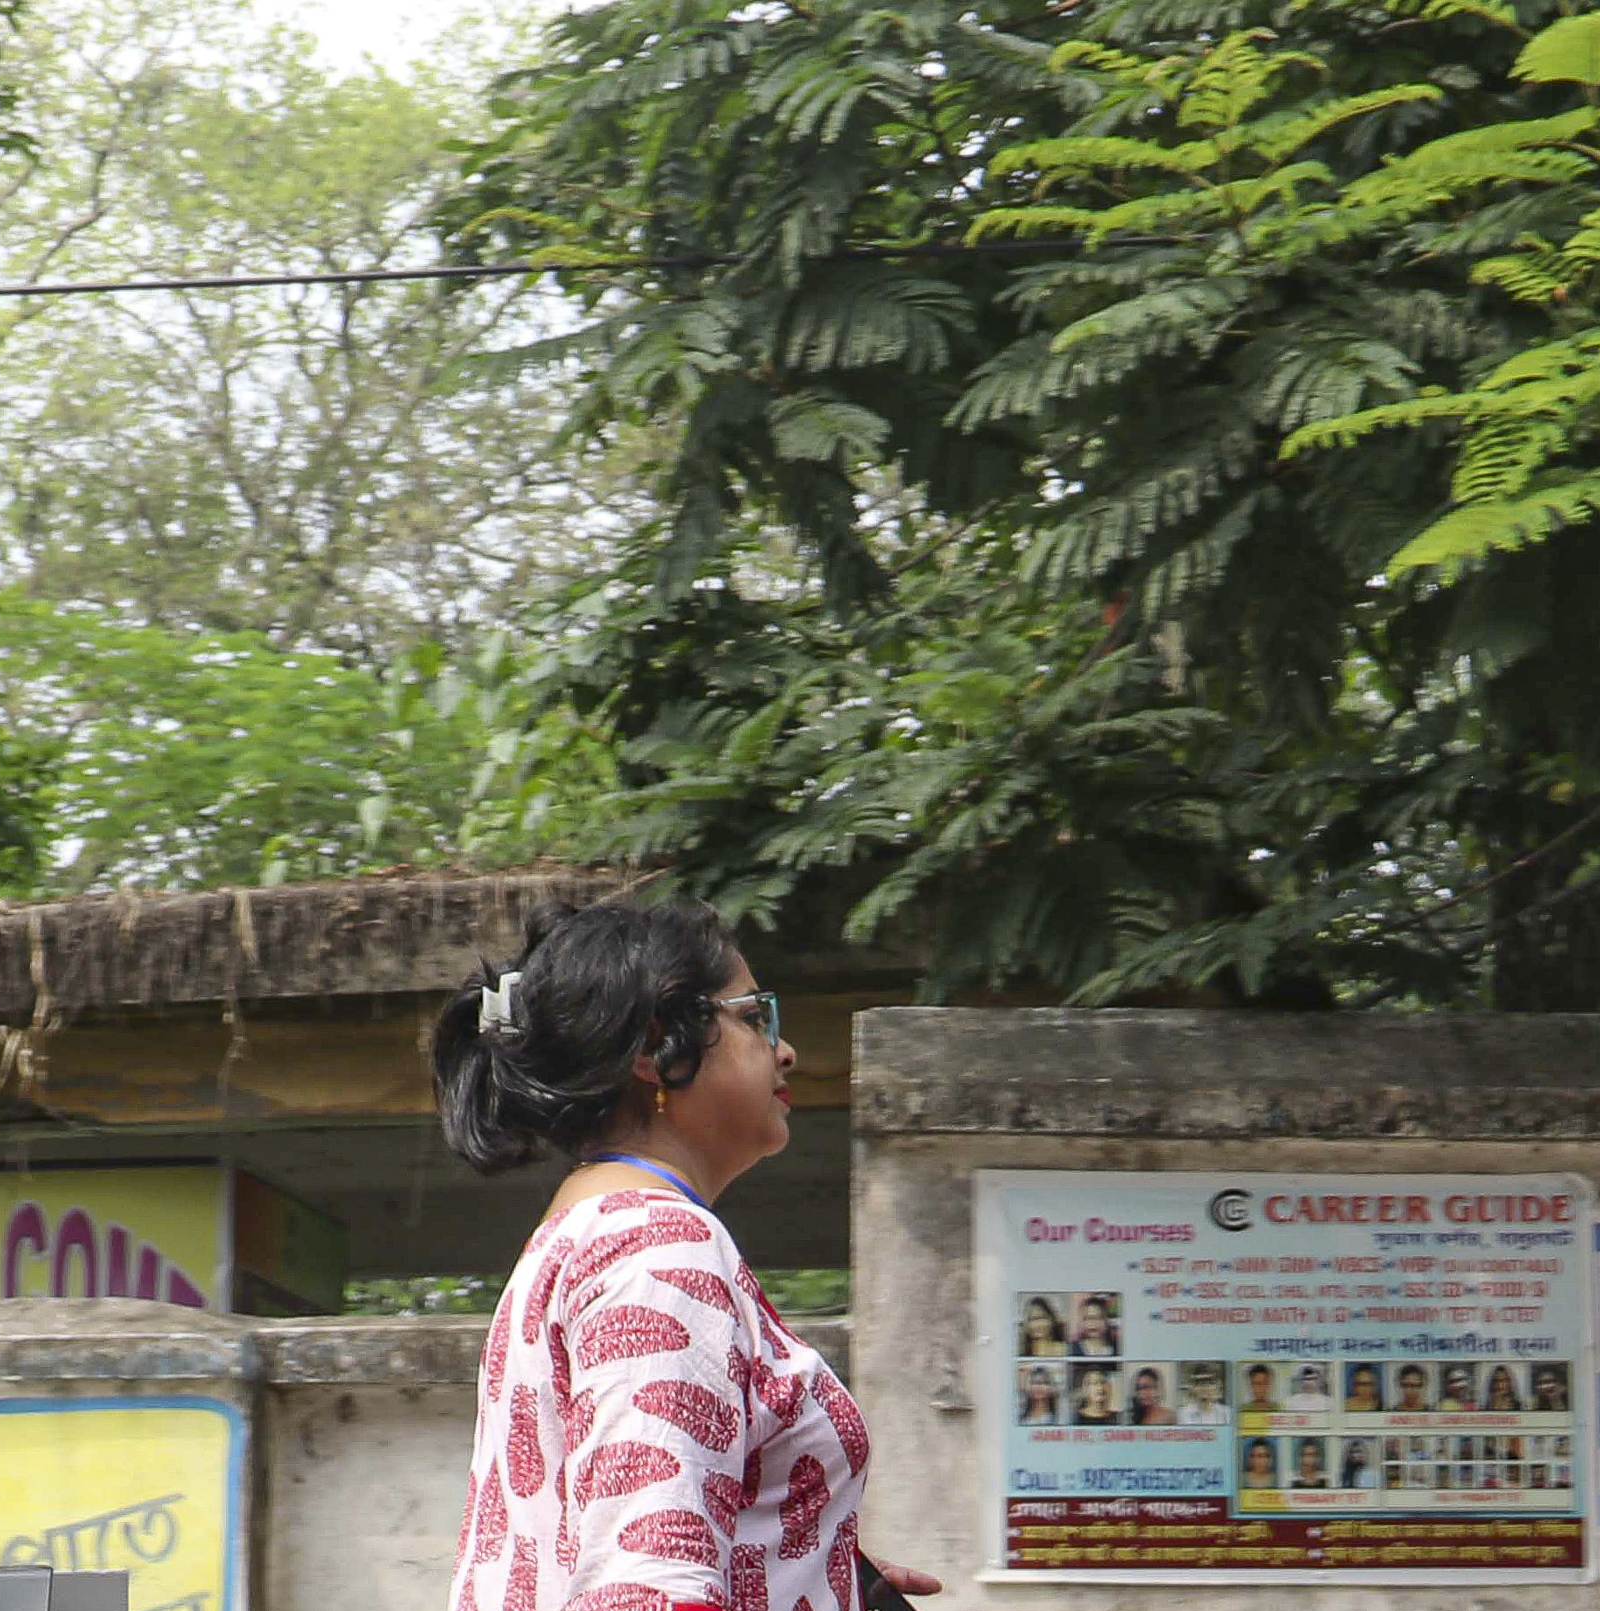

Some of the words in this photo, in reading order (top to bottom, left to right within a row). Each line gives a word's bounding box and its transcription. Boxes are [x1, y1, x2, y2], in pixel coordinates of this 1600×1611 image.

[1263, 1194, 1431, 1223] CAREER
[1443, 1193, 1575, 1223] GUIDE
[1026, 1217, 1074, 1242] Our
[1085, 1217, 1196, 1242] Courses
